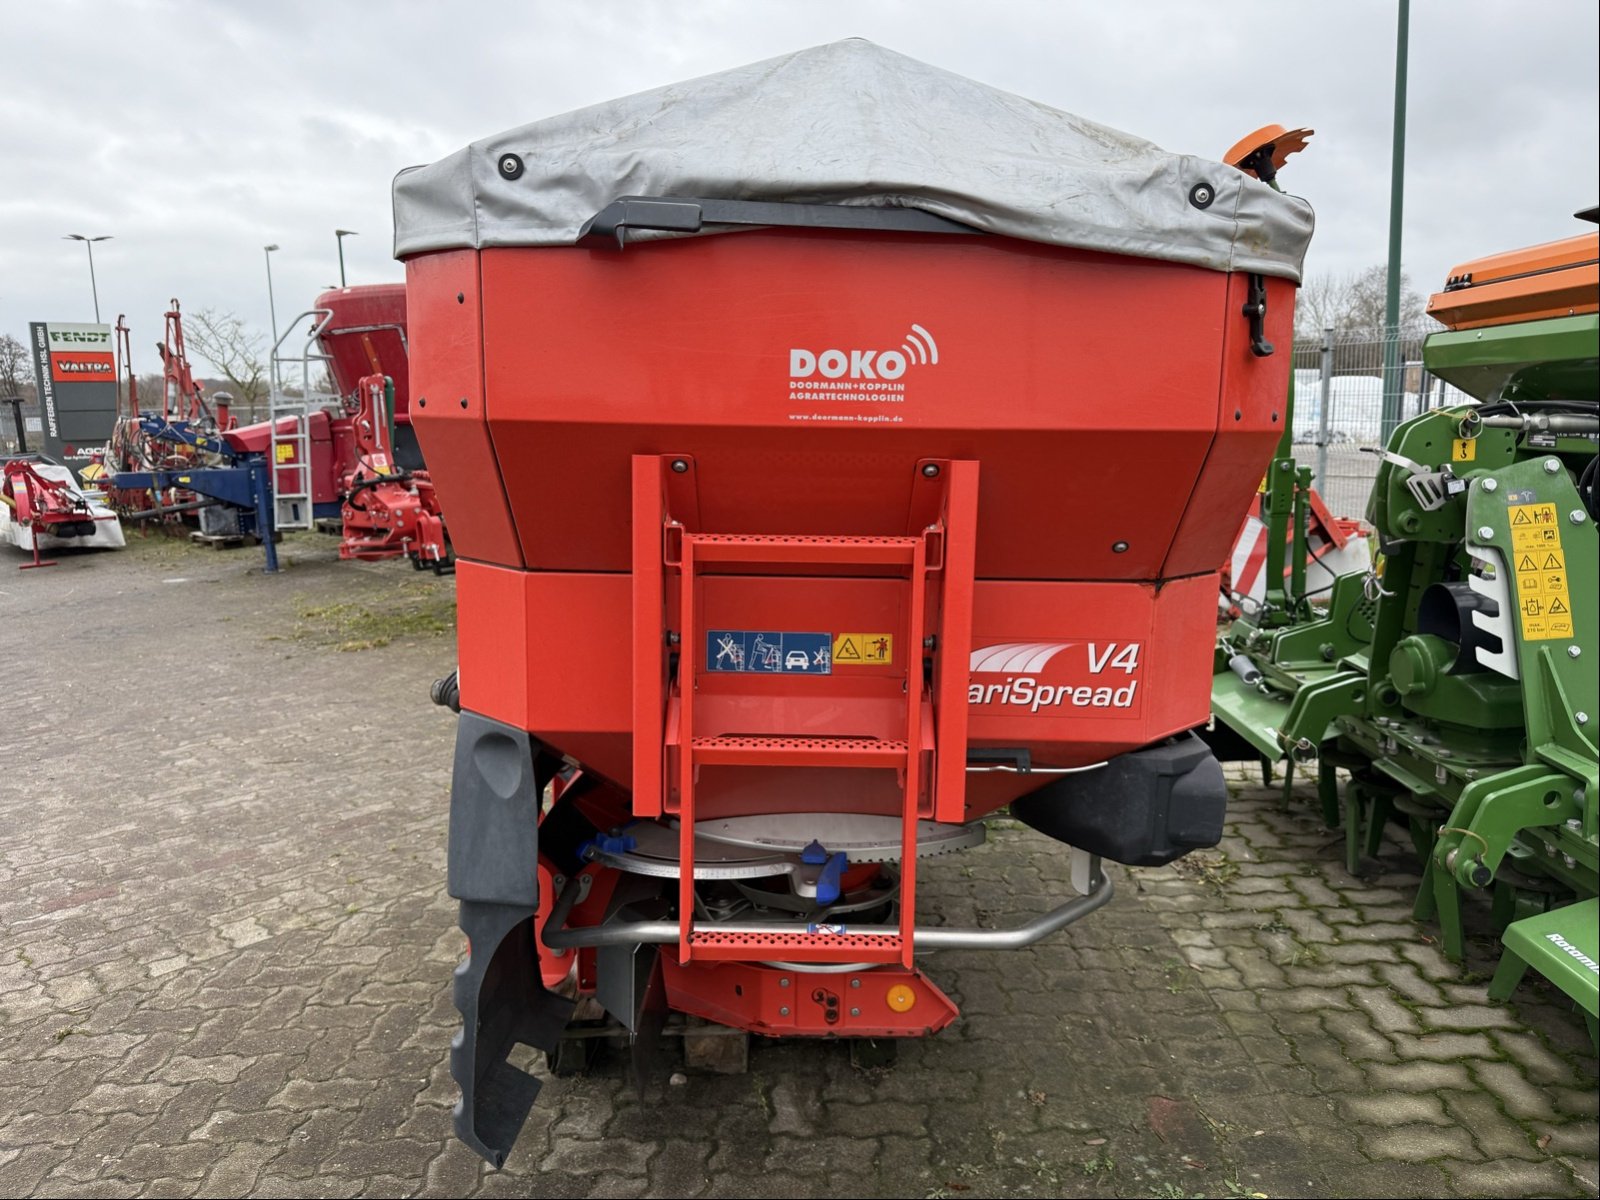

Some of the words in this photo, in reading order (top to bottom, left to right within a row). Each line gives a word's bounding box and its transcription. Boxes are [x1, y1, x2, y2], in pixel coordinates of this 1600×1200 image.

[50, 332, 110, 342] FENDT
[40, 350, 48, 364] HSL
[789, 348, 907, 380] DOKO
[57, 360, 112, 373] VALTRA
[41, 364, 52, 395] TECHNIK
[789, 381, 905, 391] DOORMANN+KOPPLIN
[789, 392, 905, 402] AGRARTECHNOLOGIEN
[46, 396, 57, 437] RAIFFEISEN
[789, 414, 904, 423] www.doormann-kopplin.de
[1087, 642, 1140, 674] V4
[968, 677, 1137, 713] ariSpread
